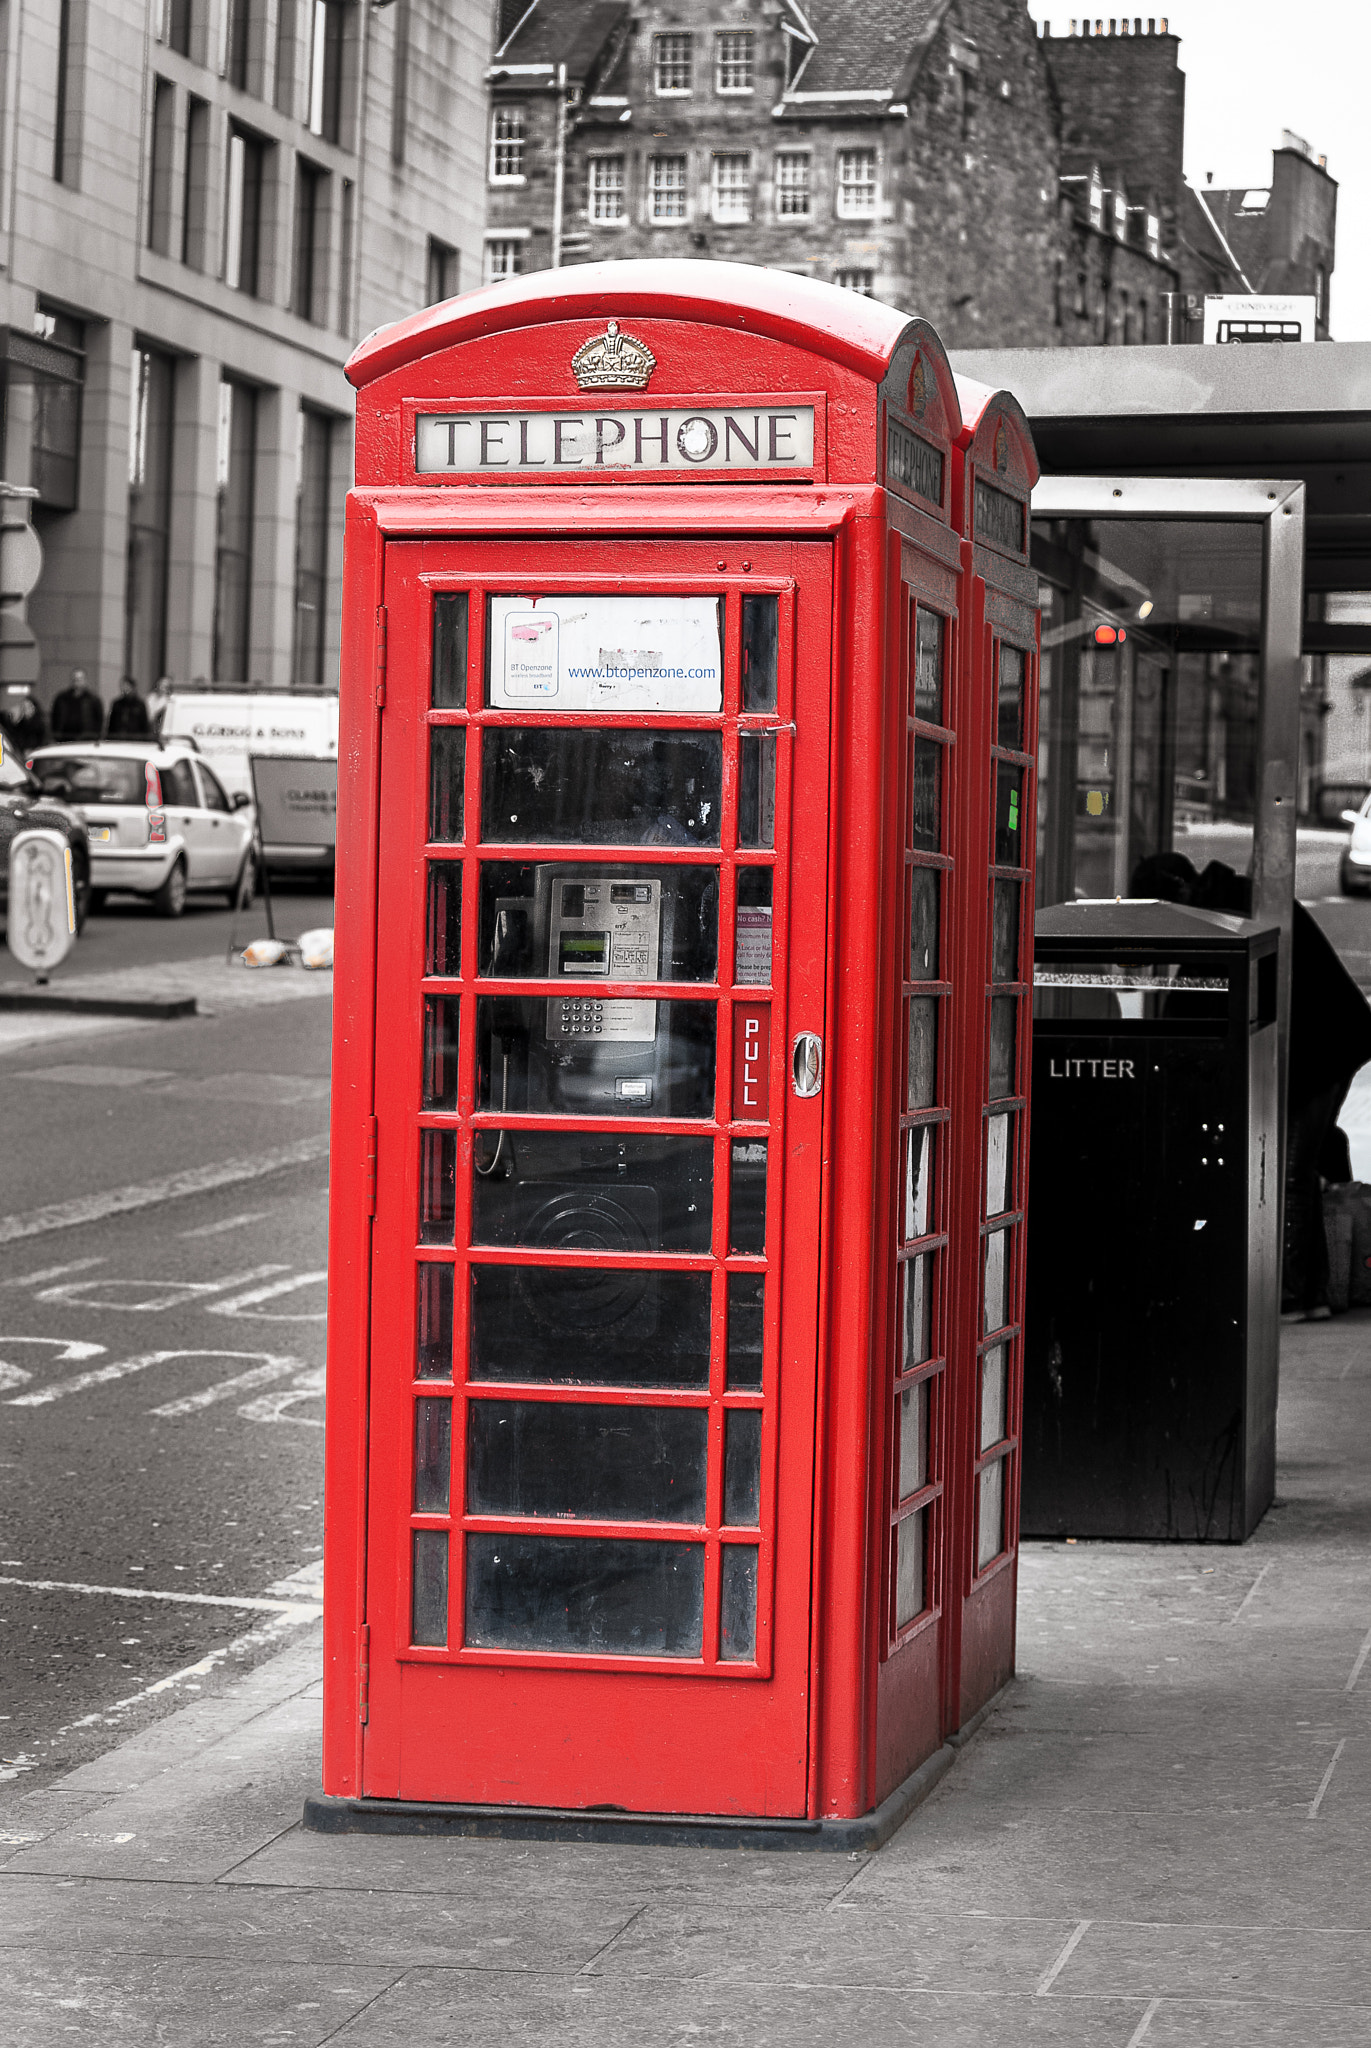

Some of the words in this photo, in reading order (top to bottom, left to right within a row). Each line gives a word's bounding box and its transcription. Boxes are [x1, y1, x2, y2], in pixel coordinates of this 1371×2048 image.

[434, 414, 798, 466] TELEPHONE
[888, 427, 941, 503] TELEPHONE
[520, 664, 552, 672] Openzone
[568, 664, 716, 681] www.btopenzone.com
[747, 915, 765, 923] cash?
[743, 1019, 759, 1105] PULL
[1050, 1059, 1135, 1078] LITTER
